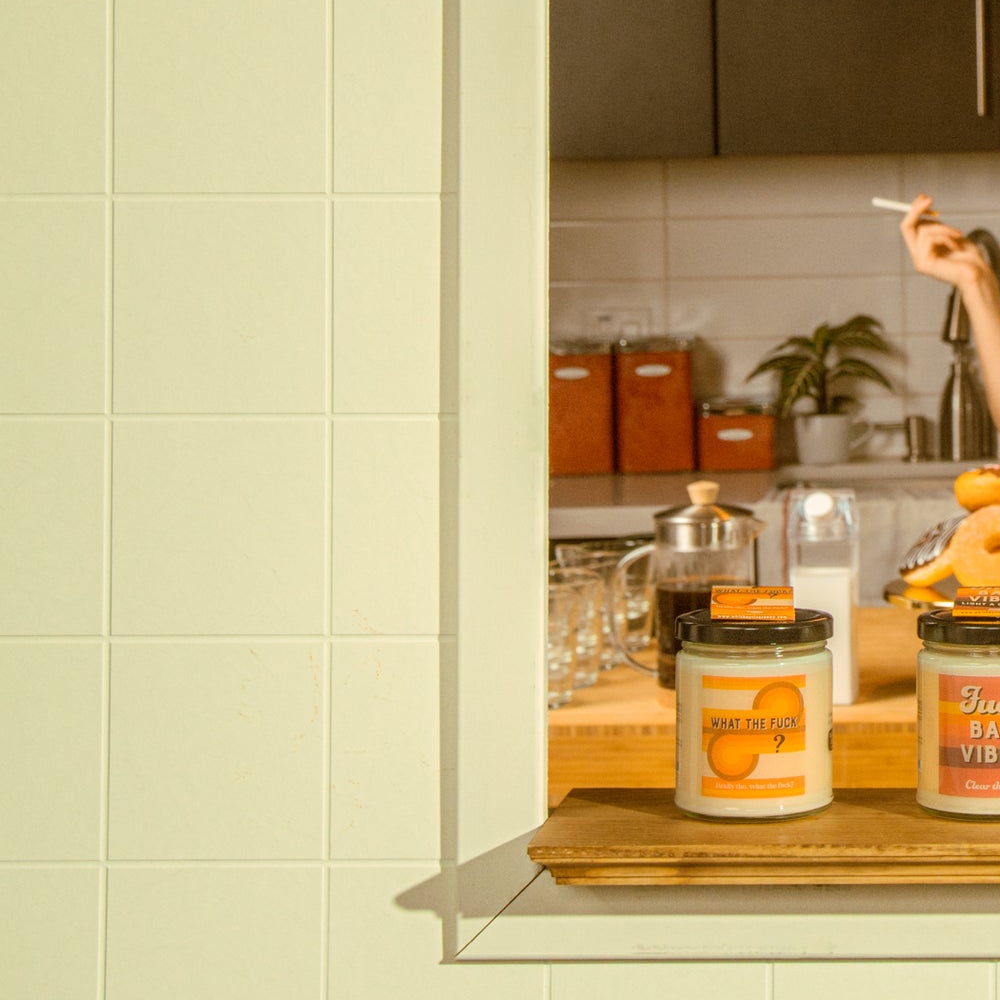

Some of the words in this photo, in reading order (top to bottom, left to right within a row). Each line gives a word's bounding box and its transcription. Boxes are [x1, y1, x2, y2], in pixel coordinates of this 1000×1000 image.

[711, 717, 740, 730] WHAT
[745, 718, 766, 730] THE
[770, 716, 798, 729] FUCK
[773, 734, 786, 753] ?
[965, 779, 990, 790] Clear
